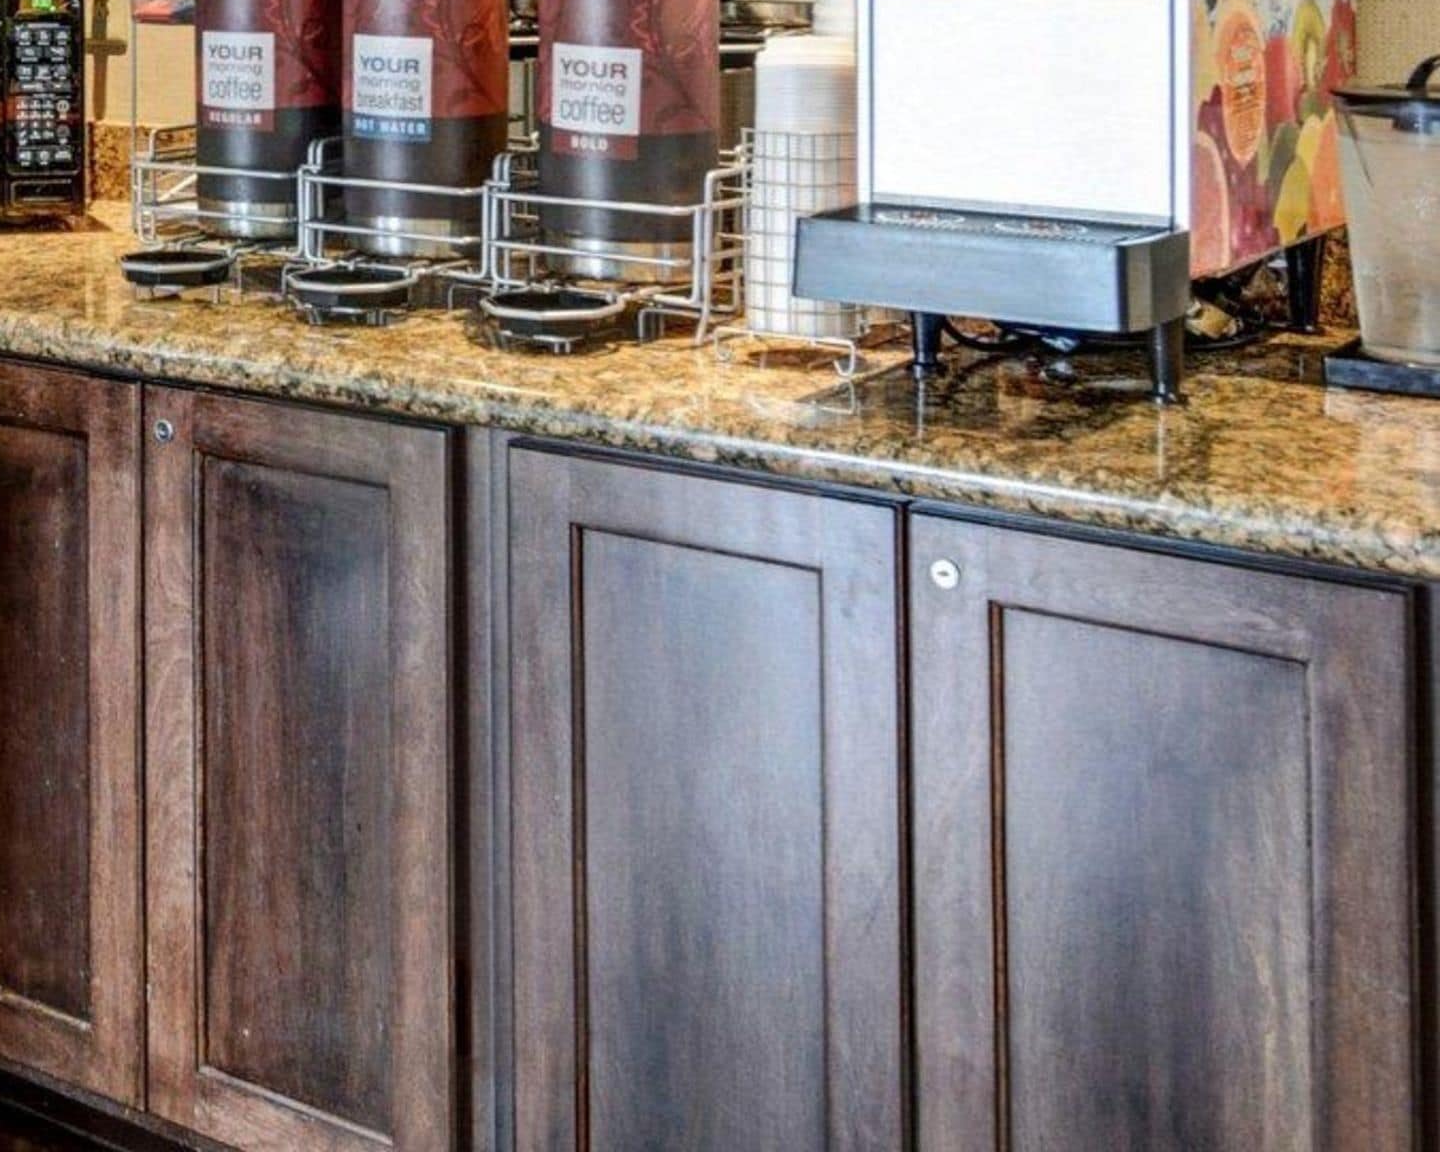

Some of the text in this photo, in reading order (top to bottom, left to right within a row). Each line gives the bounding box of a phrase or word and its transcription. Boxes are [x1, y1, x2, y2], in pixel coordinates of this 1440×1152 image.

[209, 45, 264, 60] YOUR
[360, 56, 419, 73] YOUR
[560, 57, 627, 80] YOUR
[208, 77, 263, 101] coffee
[560, 96, 625, 125] coffee
[571, 135, 609, 151] BOLD
